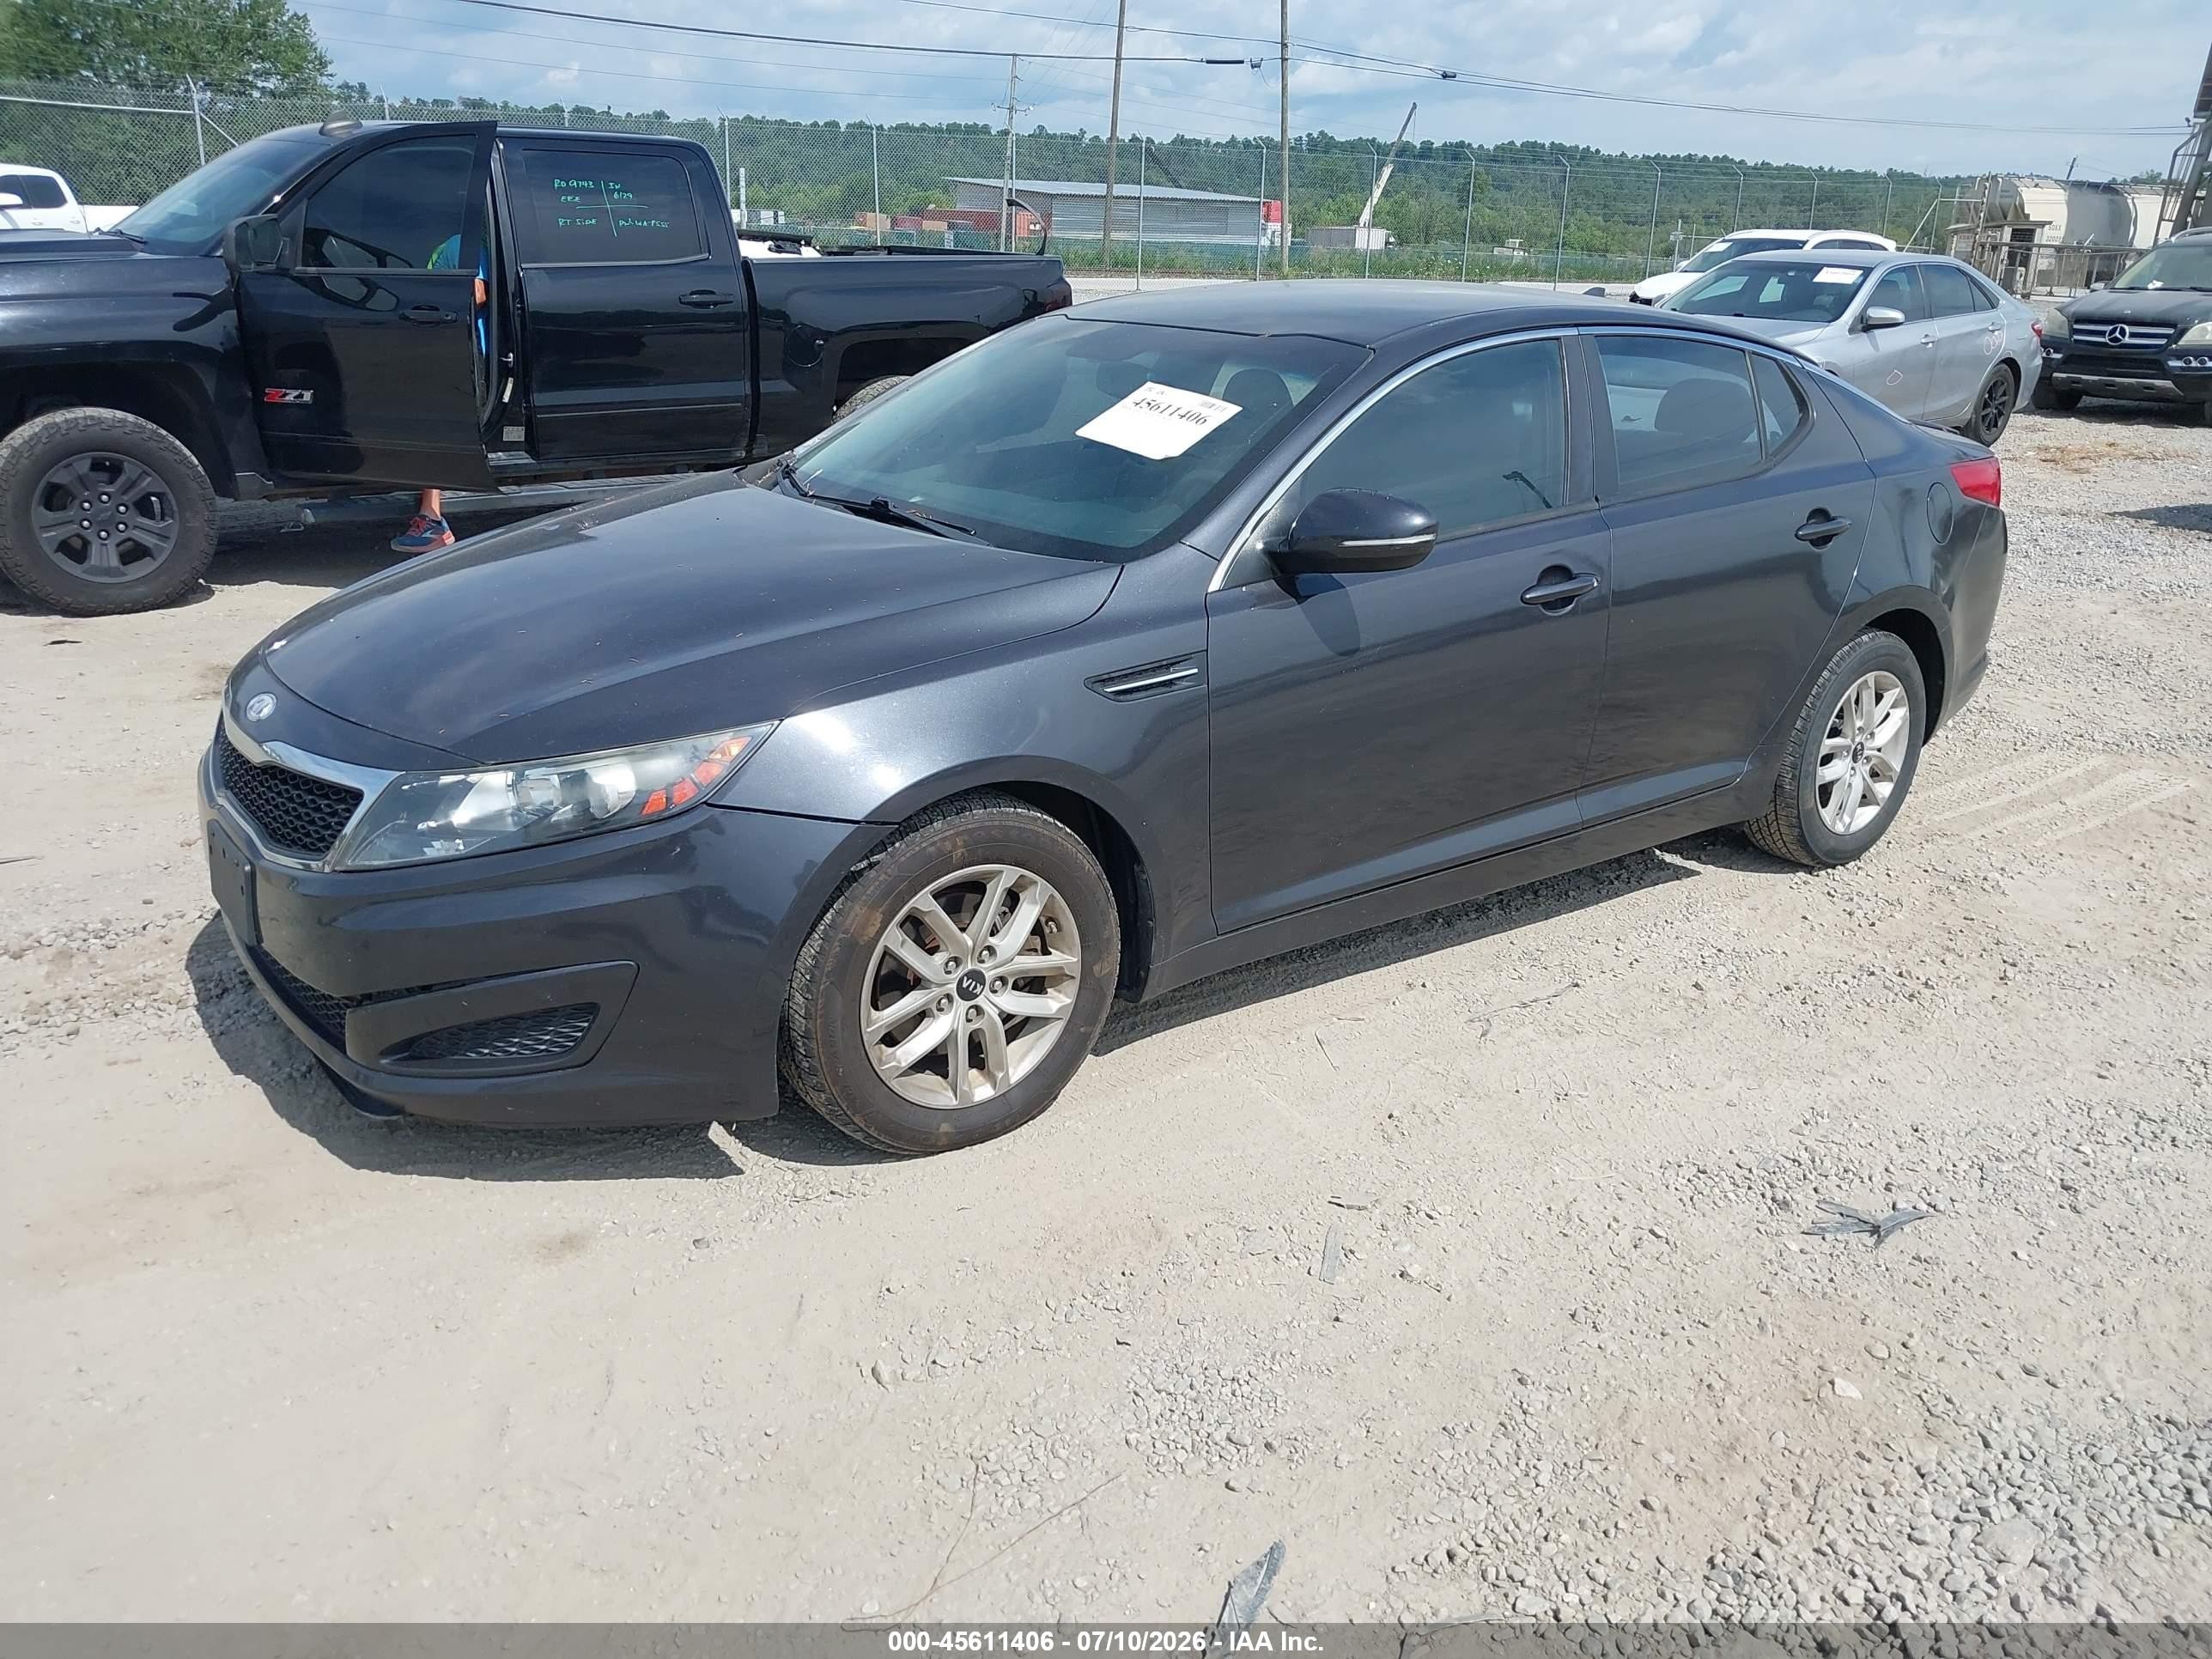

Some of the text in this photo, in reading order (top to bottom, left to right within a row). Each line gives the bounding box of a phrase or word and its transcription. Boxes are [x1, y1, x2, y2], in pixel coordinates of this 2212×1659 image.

[568, 179, 594, 188] 9743
[558, 218, 572, 228] RT
[264, 387, 314, 404] Z71
[1133, 397, 1212, 426] 45611406
[962, 975, 984, 996] KIA
